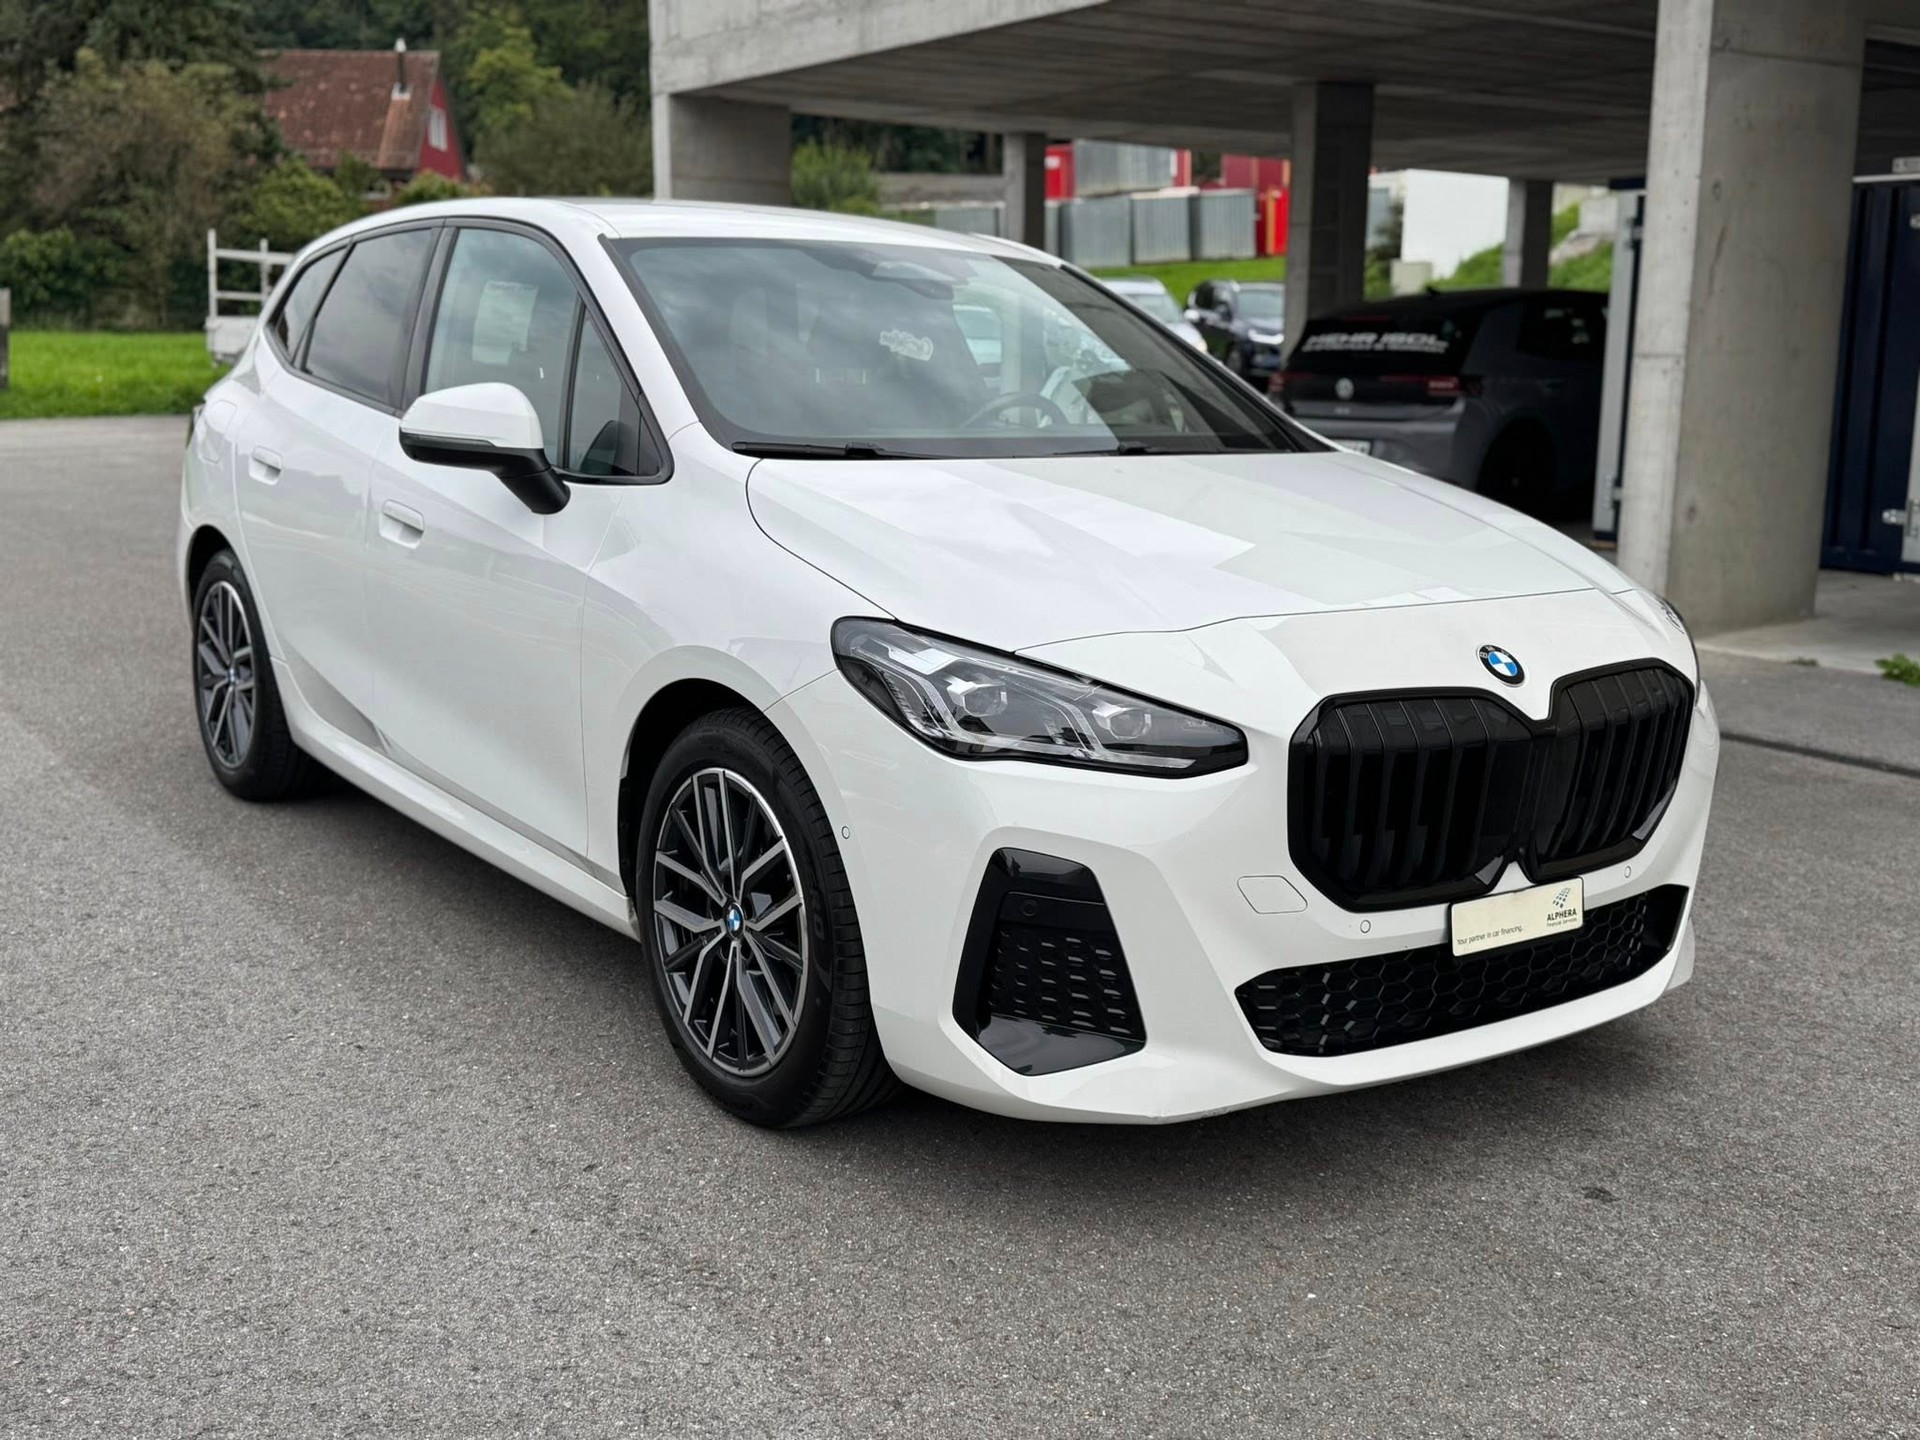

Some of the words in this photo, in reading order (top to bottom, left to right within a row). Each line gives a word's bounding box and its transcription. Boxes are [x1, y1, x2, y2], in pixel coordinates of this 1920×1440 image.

[1547, 908, 1577, 922] ALPHERA
[1457, 938, 1468, 946] Your
[1469, 934, 1486, 945] partner
